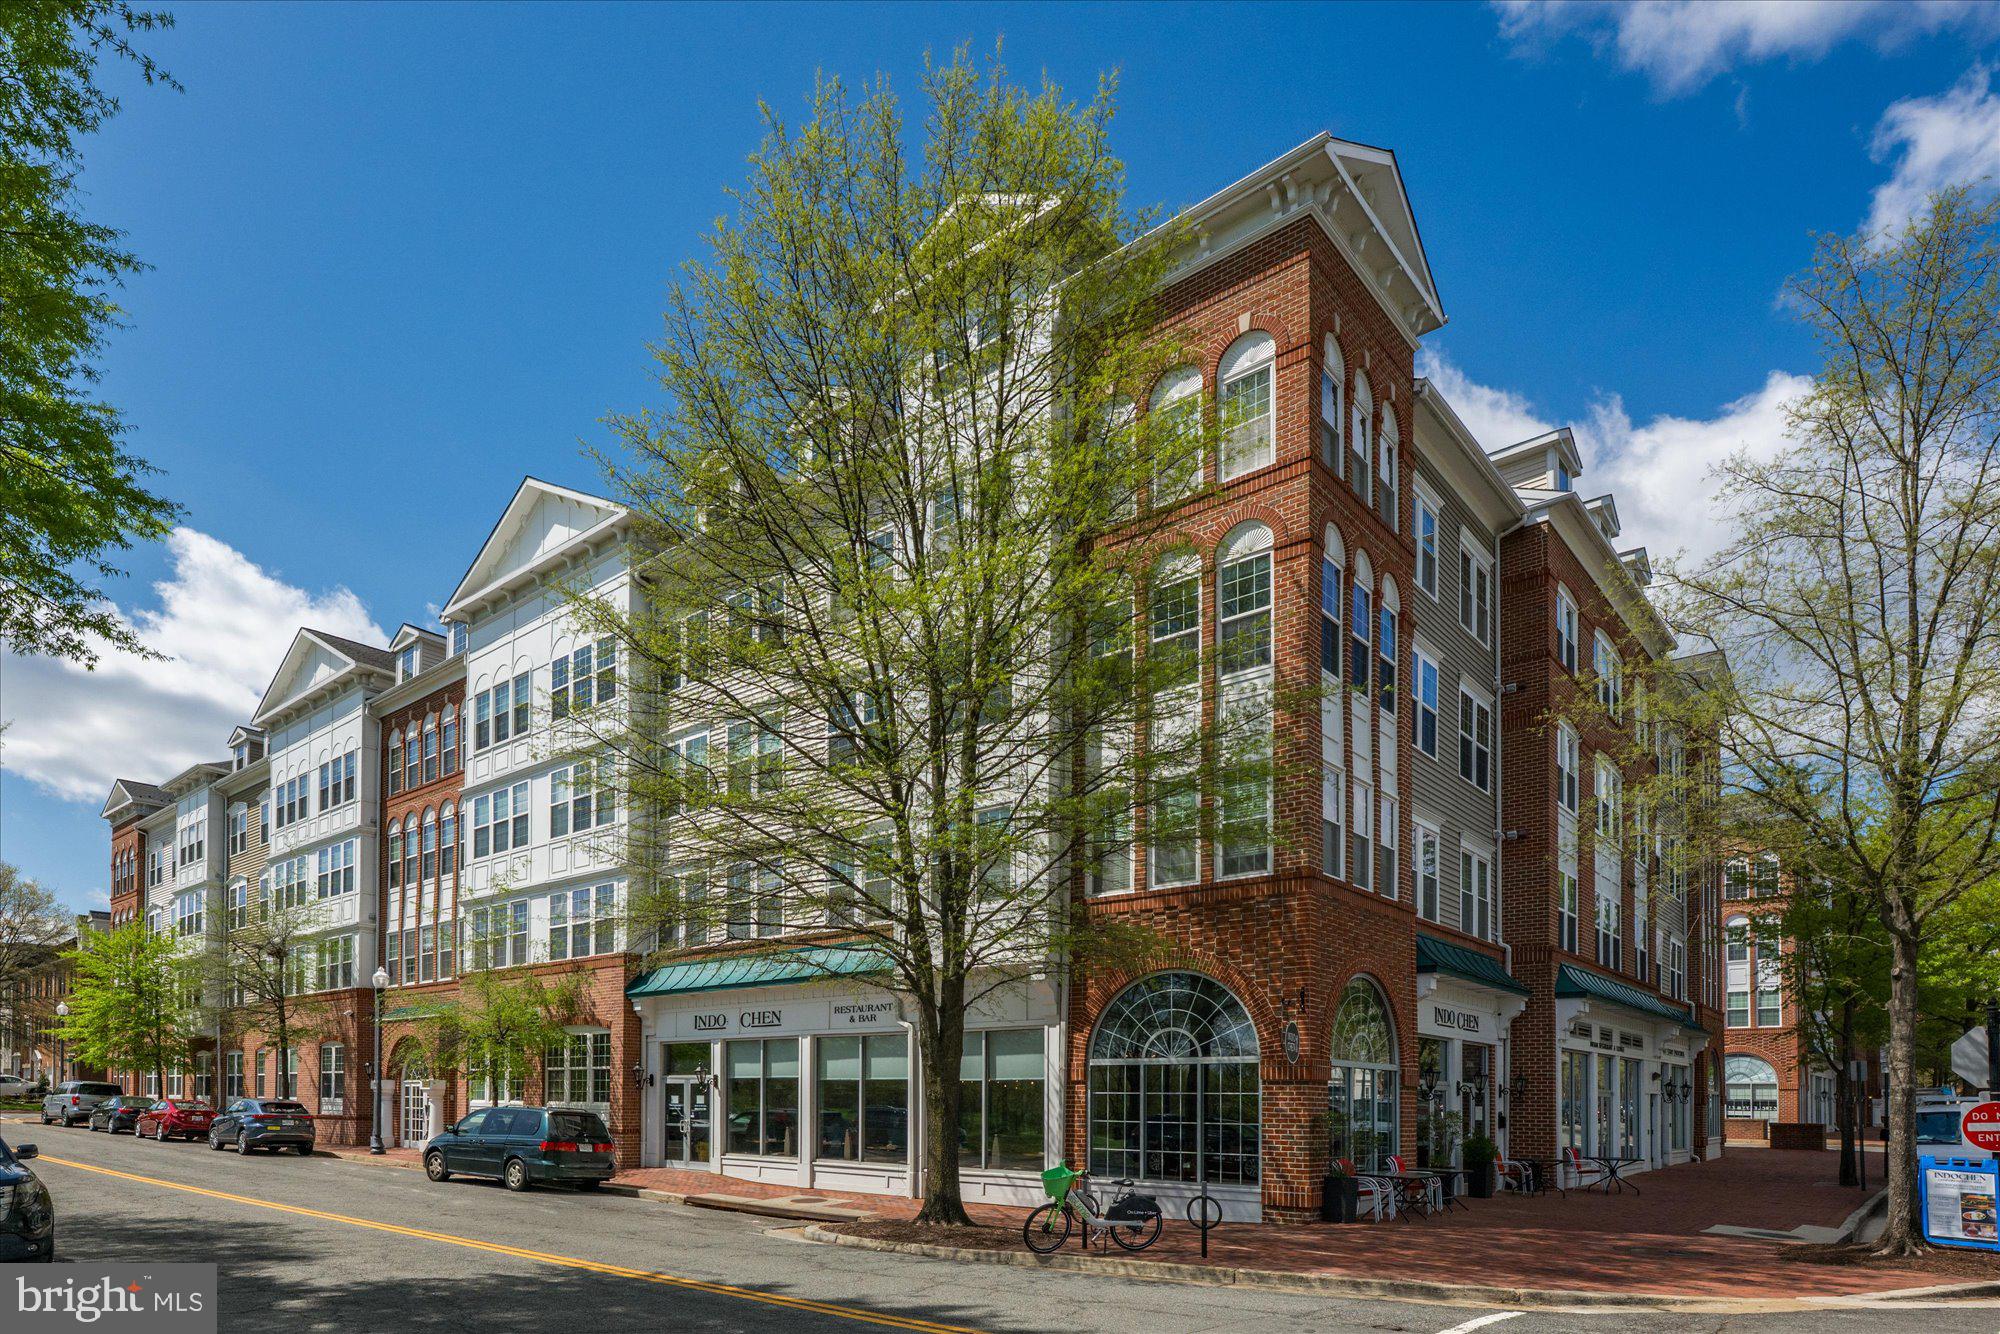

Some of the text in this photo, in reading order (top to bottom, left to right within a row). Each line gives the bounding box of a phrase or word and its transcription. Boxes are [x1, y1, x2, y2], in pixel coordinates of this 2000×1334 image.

[834, 1002, 893, 1014] RESTAURANT
[694, 1010, 782, 1030] INDO CHEN
[849, 1013, 877, 1023] & BAR
[1434, 1006, 1480, 1031] INDO CHEN
[1972, 1112, 1988, 1121] DO
